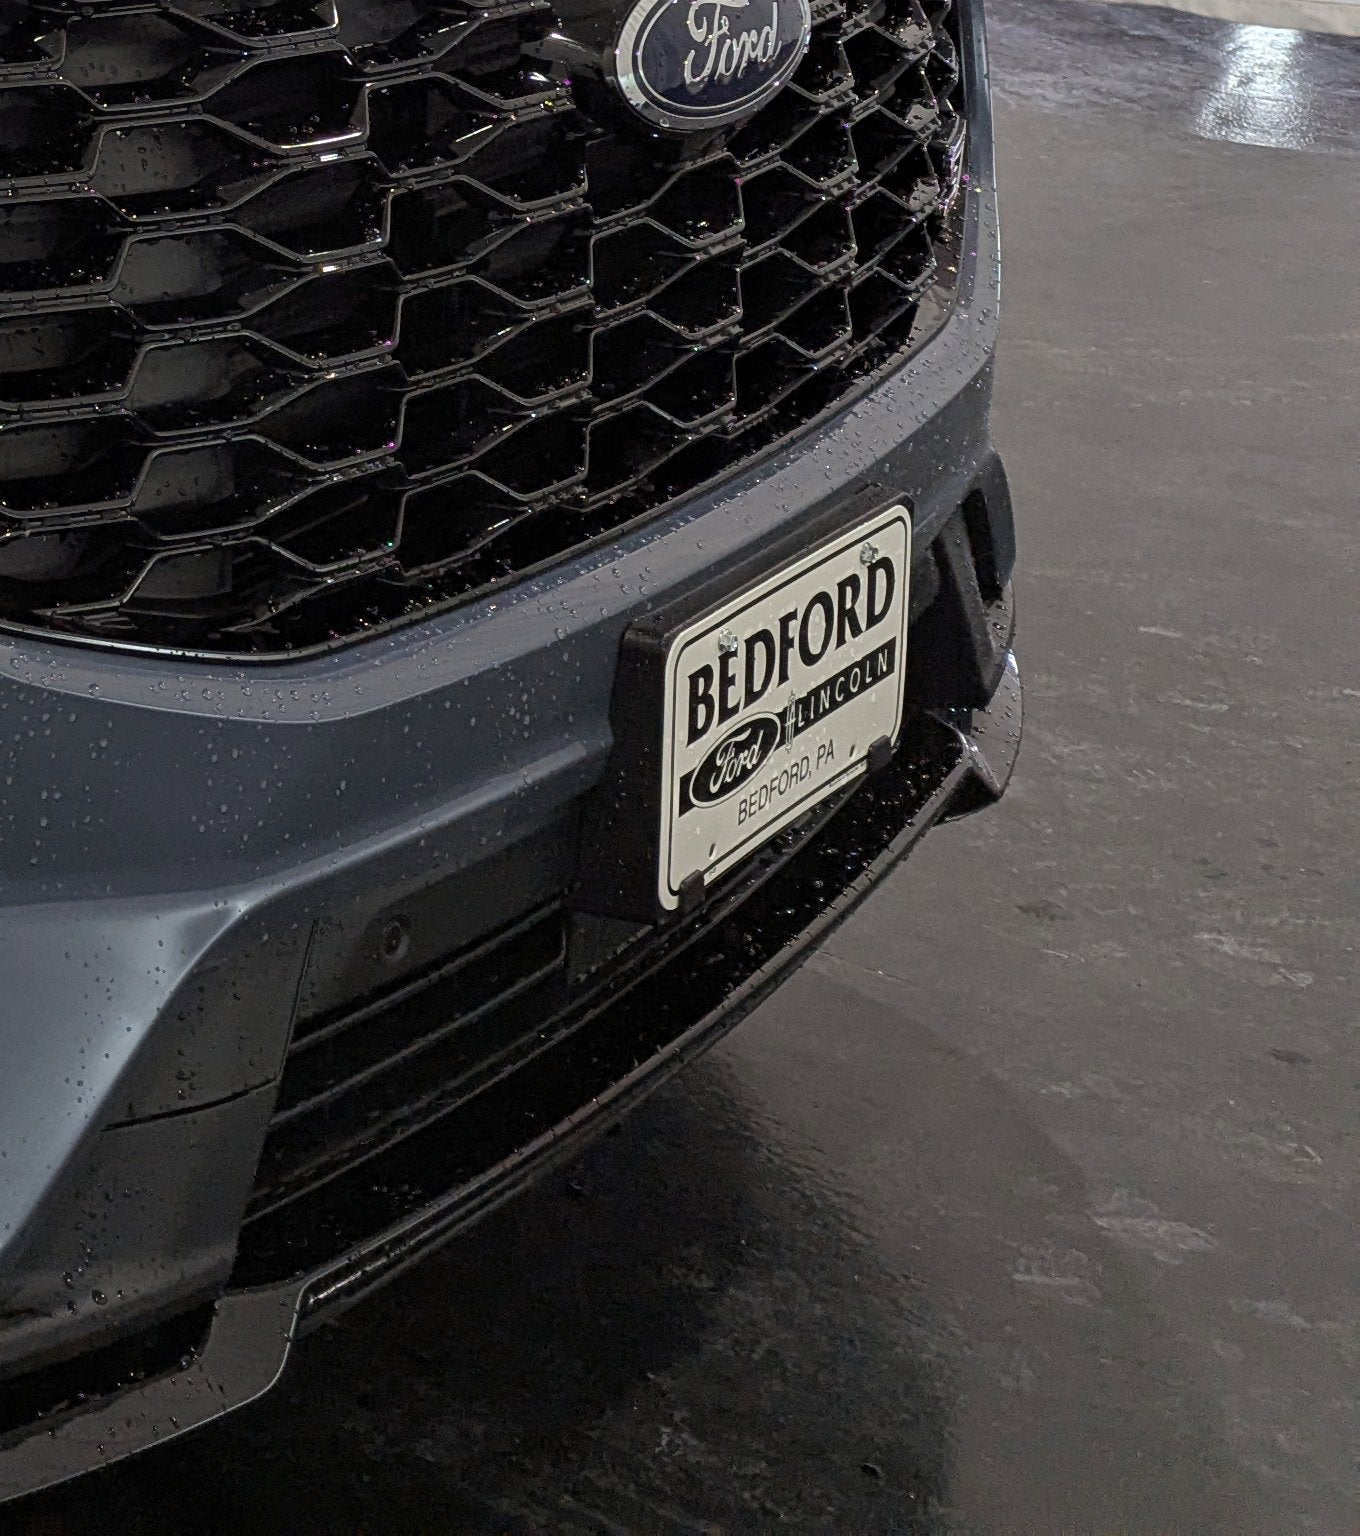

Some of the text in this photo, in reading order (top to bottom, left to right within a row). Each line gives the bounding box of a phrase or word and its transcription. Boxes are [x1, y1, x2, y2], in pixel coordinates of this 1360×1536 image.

[686, 556, 896, 748] BEDFORD
[710, 649, 888, 794] Ford LINCOLN
[816, 738, 835, 771] PA
